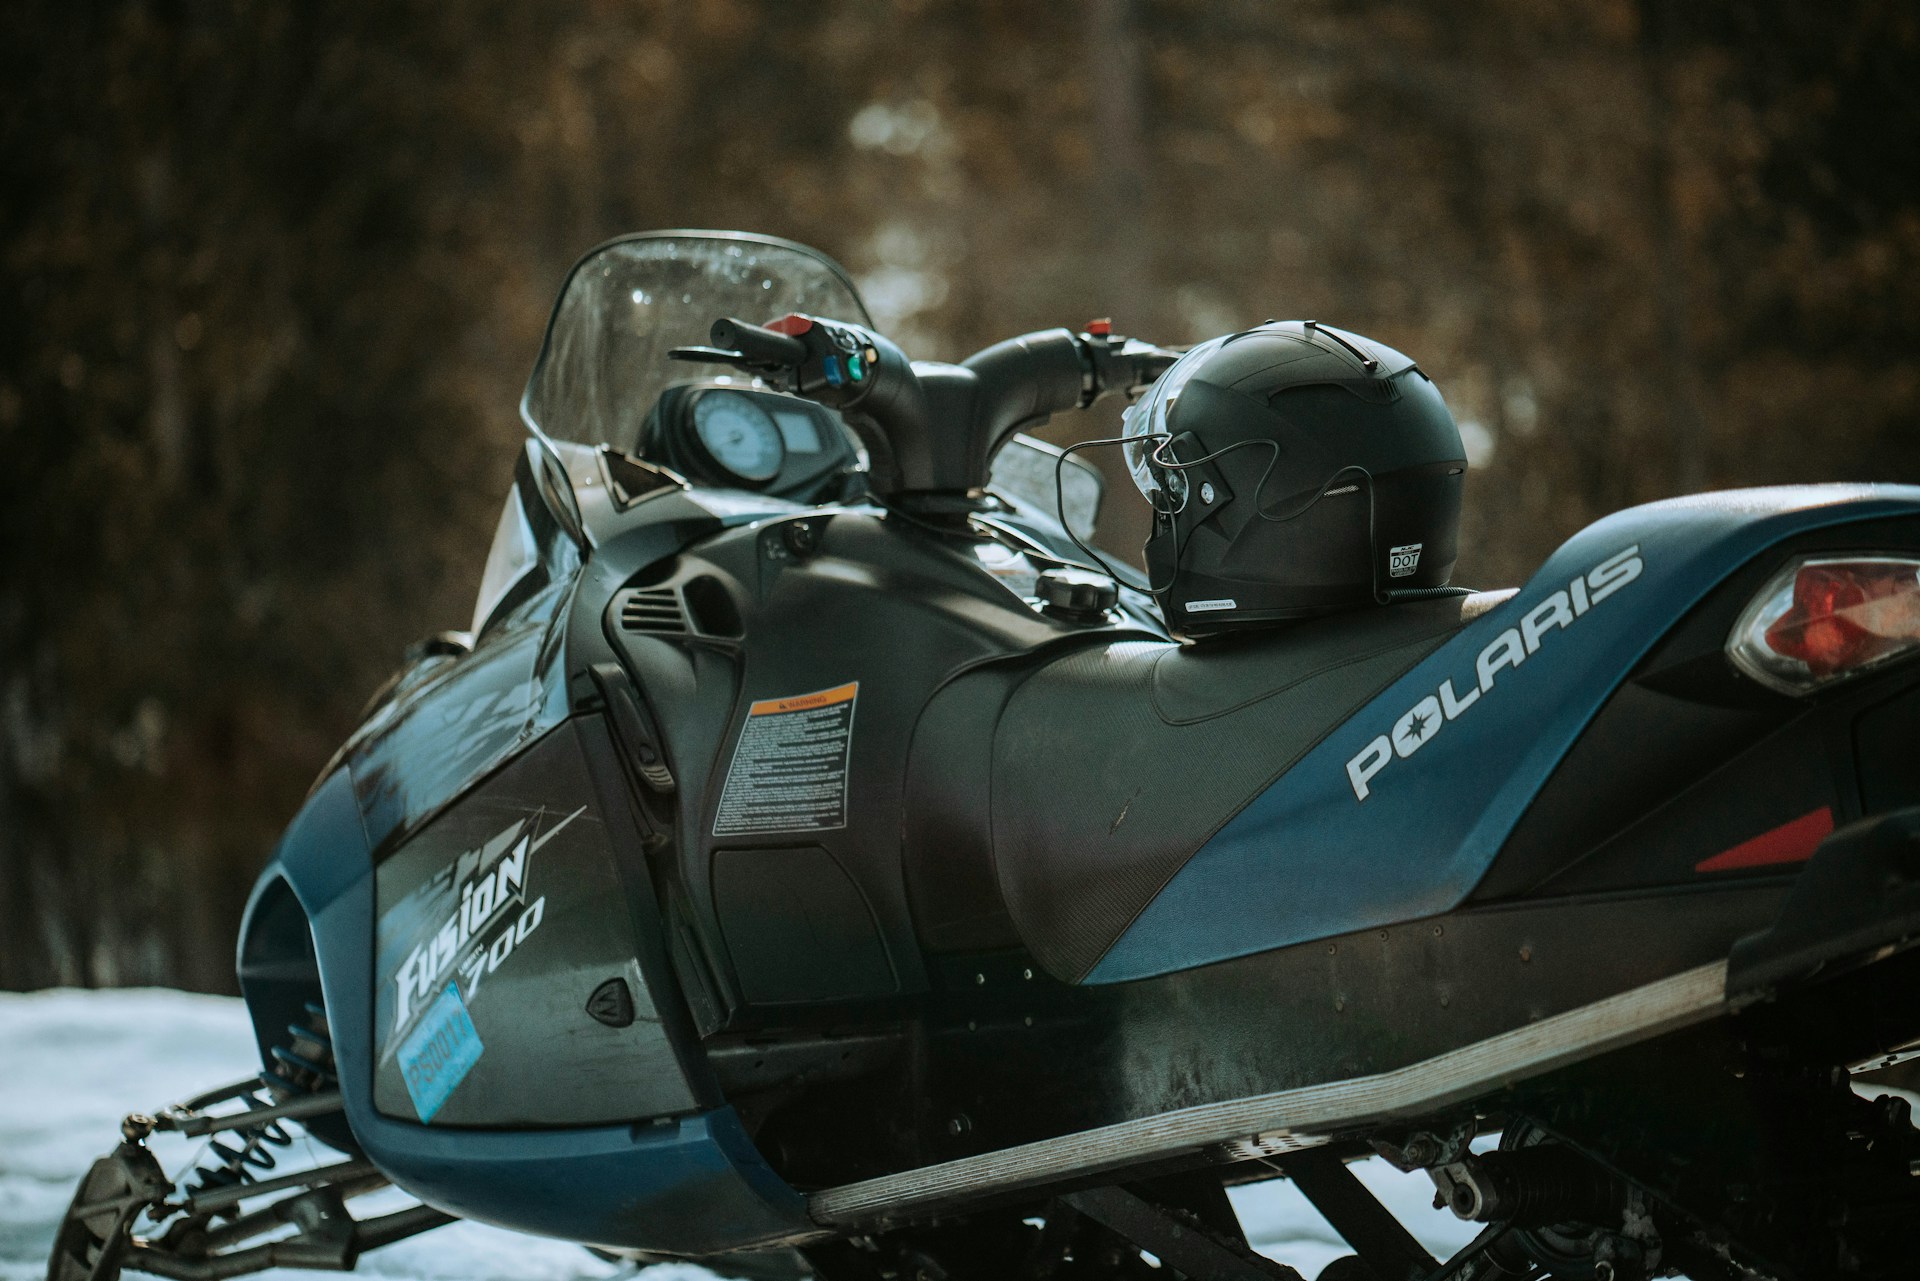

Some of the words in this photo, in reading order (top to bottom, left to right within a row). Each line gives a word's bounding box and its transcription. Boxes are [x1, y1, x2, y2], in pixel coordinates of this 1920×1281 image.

[1393, 553, 1418, 568] DOT
[788, 696, 827, 708] WARNING
[1345, 545, 1643, 801] POLARIS
[466, 895, 545, 999] 700
